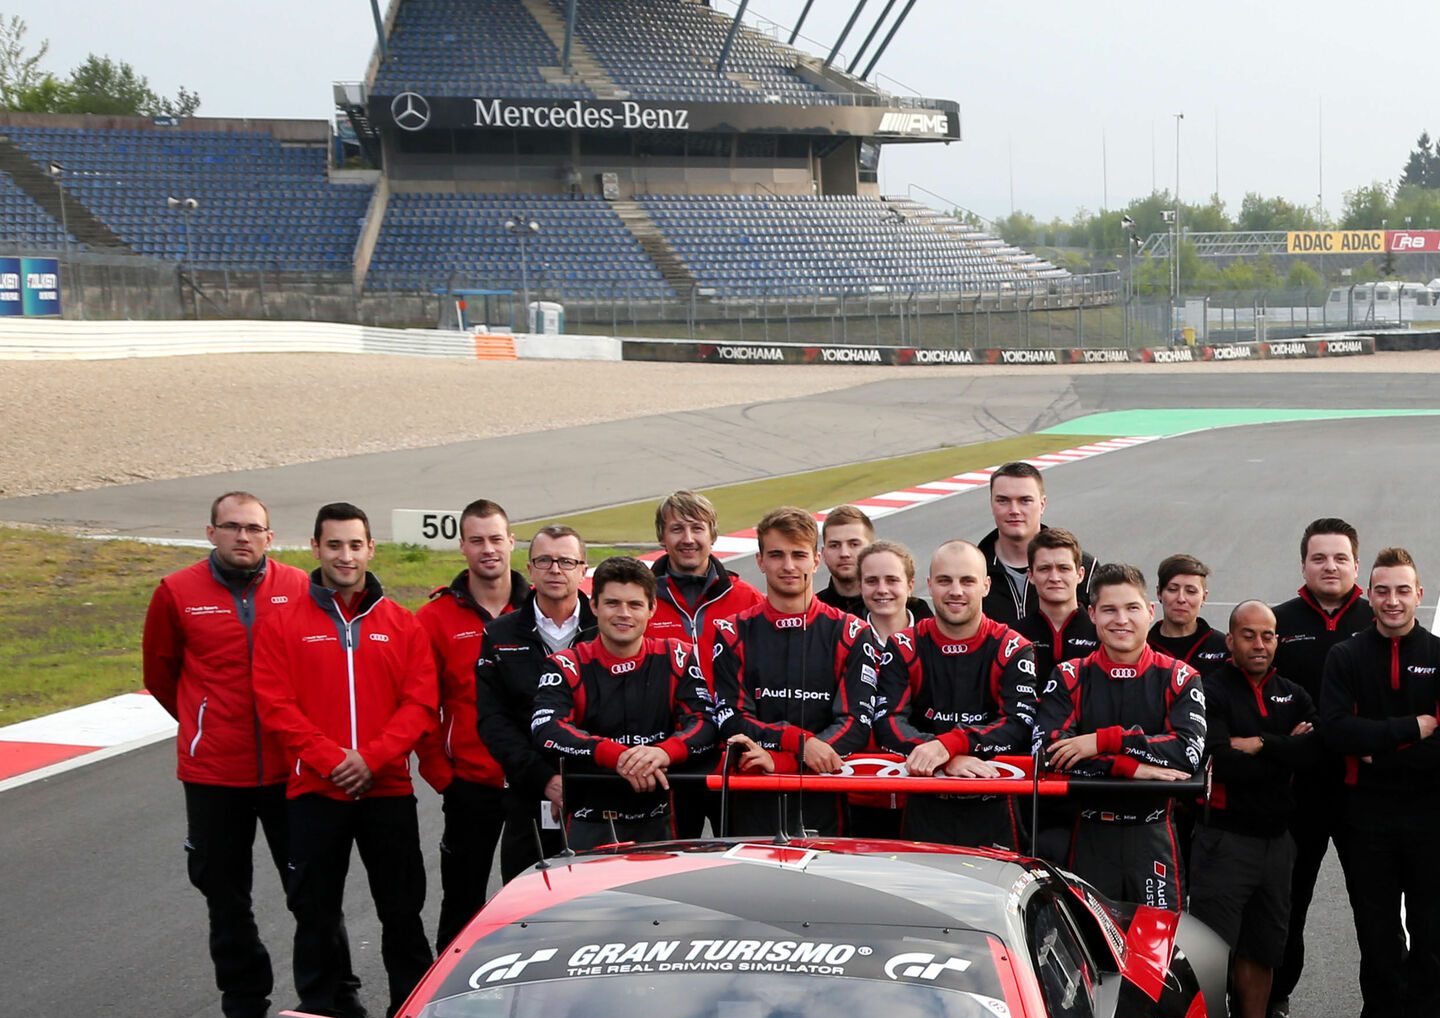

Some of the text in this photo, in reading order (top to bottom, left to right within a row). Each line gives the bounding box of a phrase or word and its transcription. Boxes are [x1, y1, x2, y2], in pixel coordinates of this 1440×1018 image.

[473, 98, 690, 130] Mercedes-Benz
[1293, 233, 1381, 250] ADAC ADAC
[716, 345, 784, 361] YOKOHAMA
[1327, 340, 1362, 354] YOKOHAMA
[821, 348, 881, 363] YOKOHAMA
[915, 350, 973, 363] YOKOHAMA
[1001, 349, 1056, 363] YOKOHAMA
[1083, 349, 1129, 363] YOKOHAMA
[1154, 349, 1193, 363] YOKOHAMA
[421, 514, 458, 540] 50
[761, 687, 831, 701] Audi Sport
[568, 940, 680, 966] GRAN
[567, 962, 845, 976] THE REAL DRIVING SIMULATOR
